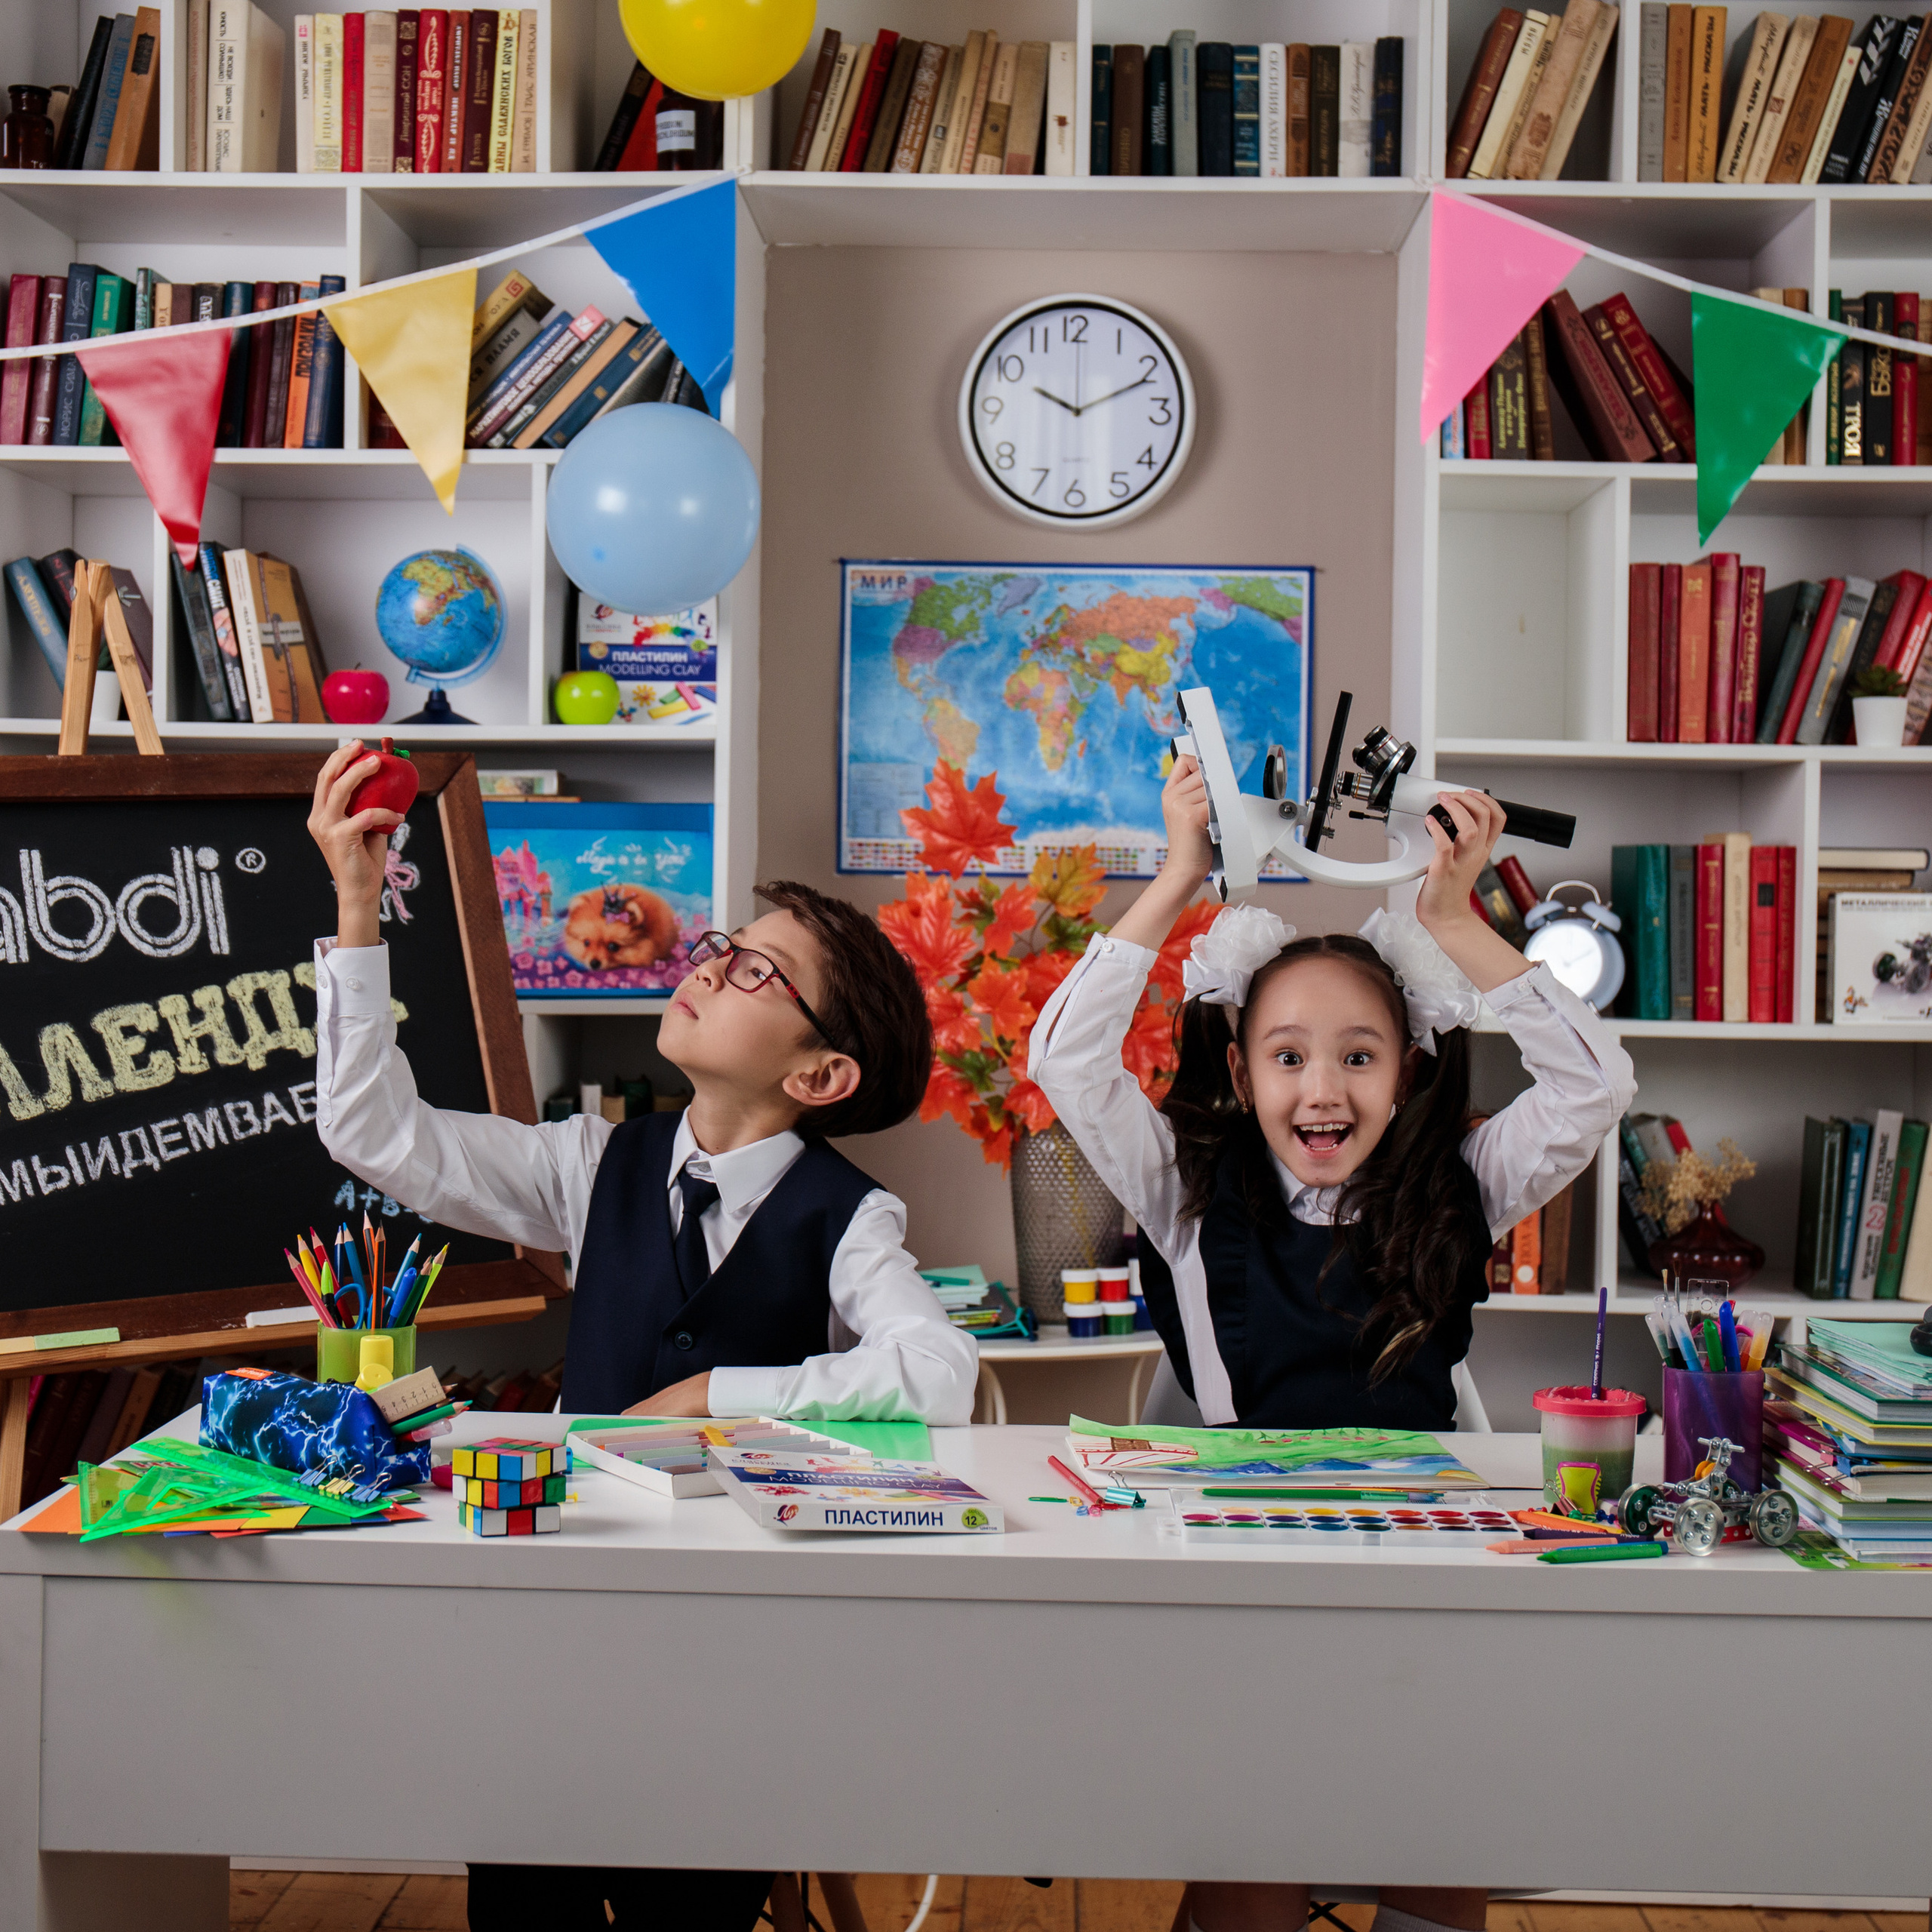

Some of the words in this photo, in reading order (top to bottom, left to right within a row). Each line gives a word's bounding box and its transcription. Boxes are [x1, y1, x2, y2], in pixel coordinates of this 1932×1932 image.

[501, 35, 513, 66] БОГОВ
[525, 23, 537, 78] АФИНСКАЯ
[1703, 15, 1715, 73] РАССКАЗЫ
[523, 82, 535, 107] ТАИС
[1269, 51, 1279, 114] СЕСИЛИЯ
[1746, 78, 1763, 115] МАТЬ
[497, 70, 511, 136] СЛАВЯНСКИХ
[1701, 82, 1709, 117] МАТЬ
[450, 97, 459, 134] НЕКТАР
[521, 117, 532, 151] ЕФРЕМОВ
[1268, 118, 1279, 161] АХЕРН
[1727, 120, 1750, 178] РАССКАЗЫ
[1030, 326, 1048, 353] 11
[1063, 315, 1089, 343] 12
[1117, 328, 1121, 355] 1
[294, 316, 316, 379] ПРИЗРАКИ
[484, 327, 522, 367] ПЛАМЯ
[515, 328, 575, 392] ЦЕНООБРАЗОВАНИЕ
[997, 354, 1024, 383] 10
[1139, 355, 1158, 383] 2
[1495, 373, 1506, 406] Пушкин
[60, 397, 73, 438] МОРИС
[982, 396, 1004, 425] 9
[1149, 397, 1171, 426] 3
[1844, 401, 1861, 457] ТРОЯ
[995, 441, 1015, 470] 8
[1135, 445, 1157, 470] 4
[1030, 468, 1051, 497] 7
[1064, 478, 1086, 508] 6
[1109, 472, 1130, 498] 5
[206, 578, 227, 611] СМИТ
[860, 574, 909, 590] МИР
[598, 664, 671, 676] MODELLING
[672, 664, 702, 676] CLAY
[612, 651, 688, 663] ПЛАСТИЛИН
[232, 666, 248, 702] ОХОТНИКИ
[769, 1475, 891, 1488] MODELLING
[895, 1481, 942, 1490] CLAY
[787, 1471, 917, 1484] ПЛАСТИЛИН
[825, 1509, 943, 1526] ПЛАСТИЛИН
[965, 1515, 977, 1525] 12
